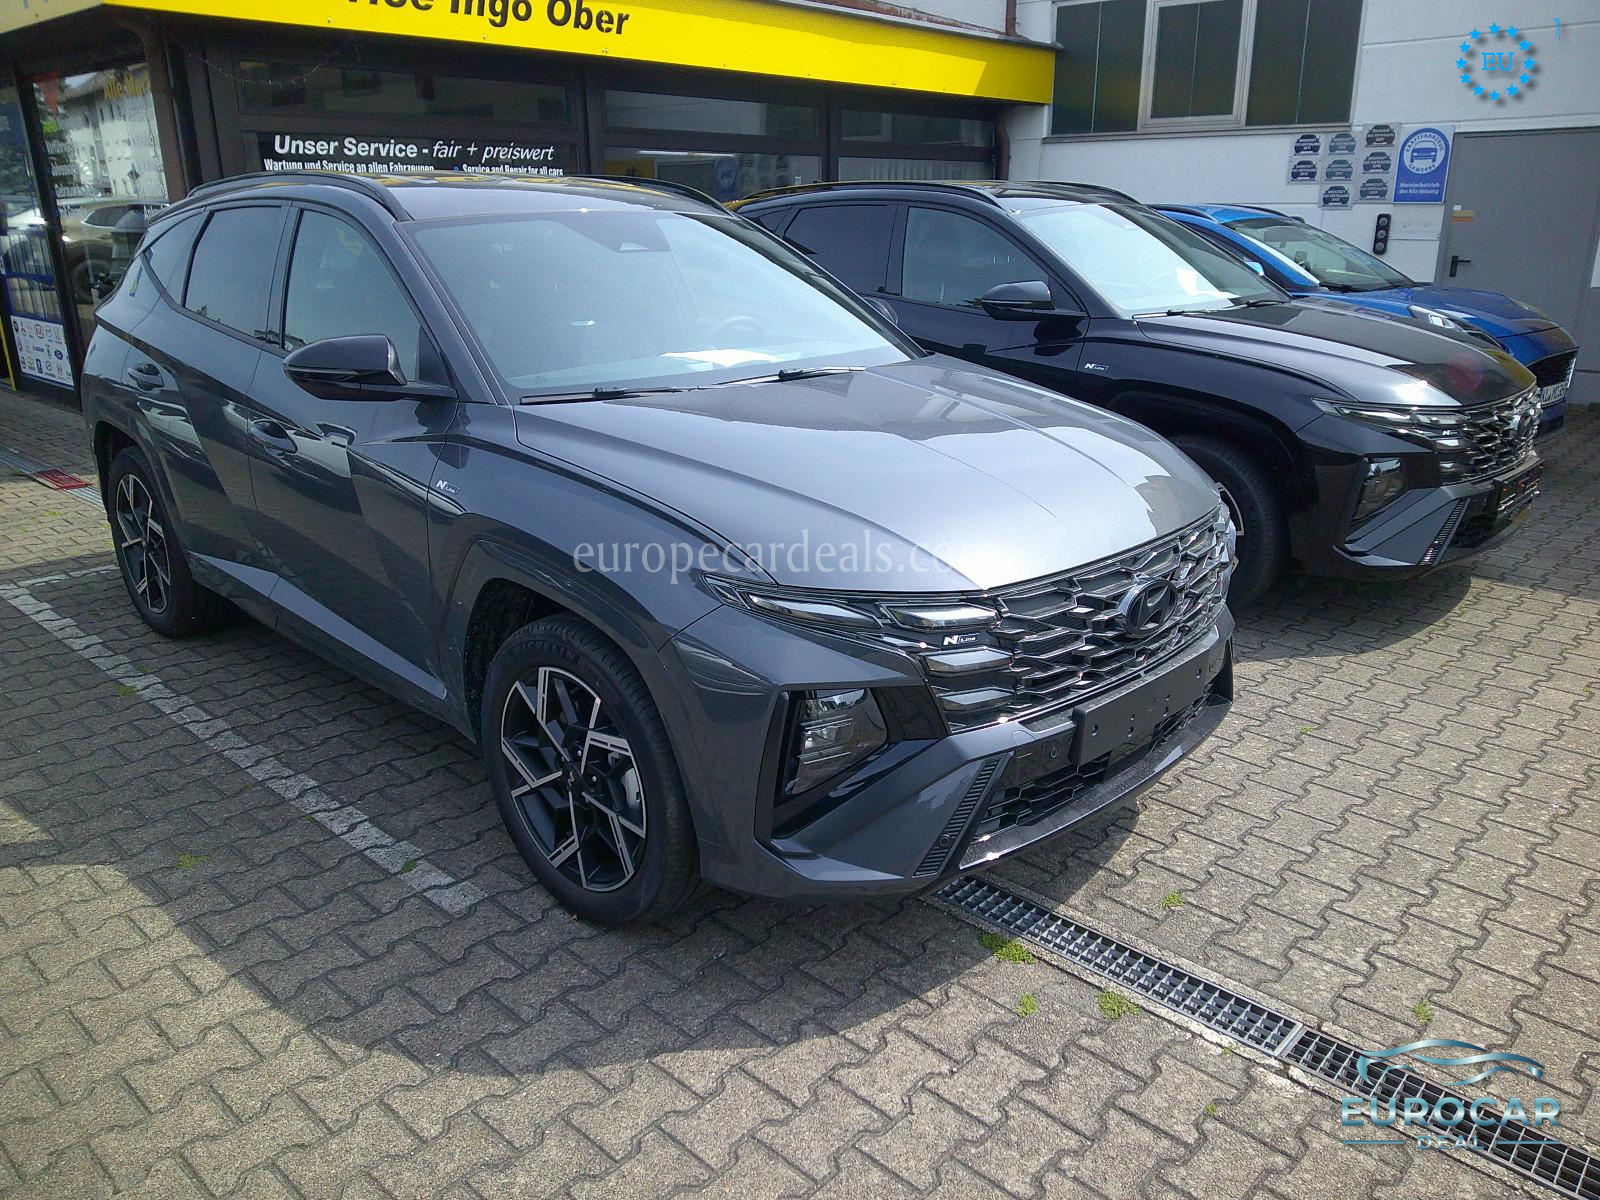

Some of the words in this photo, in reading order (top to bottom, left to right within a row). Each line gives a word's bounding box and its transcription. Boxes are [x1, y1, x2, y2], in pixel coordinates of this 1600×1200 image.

[547, 0, 630, 35] Ober
[274, 134, 338, 155] Unser
[344, 137, 418, 158] Service
[432, 140, 463, 158] fair
[482, 142, 554, 163] preiswert
[304, 160, 321, 170] und
[322, 160, 355, 173] Service
[356, 163, 367, 173] an
[368, 161, 389, 173] allen
[462, 163, 490, 173] Service
[548, 167, 564, 176] cars
